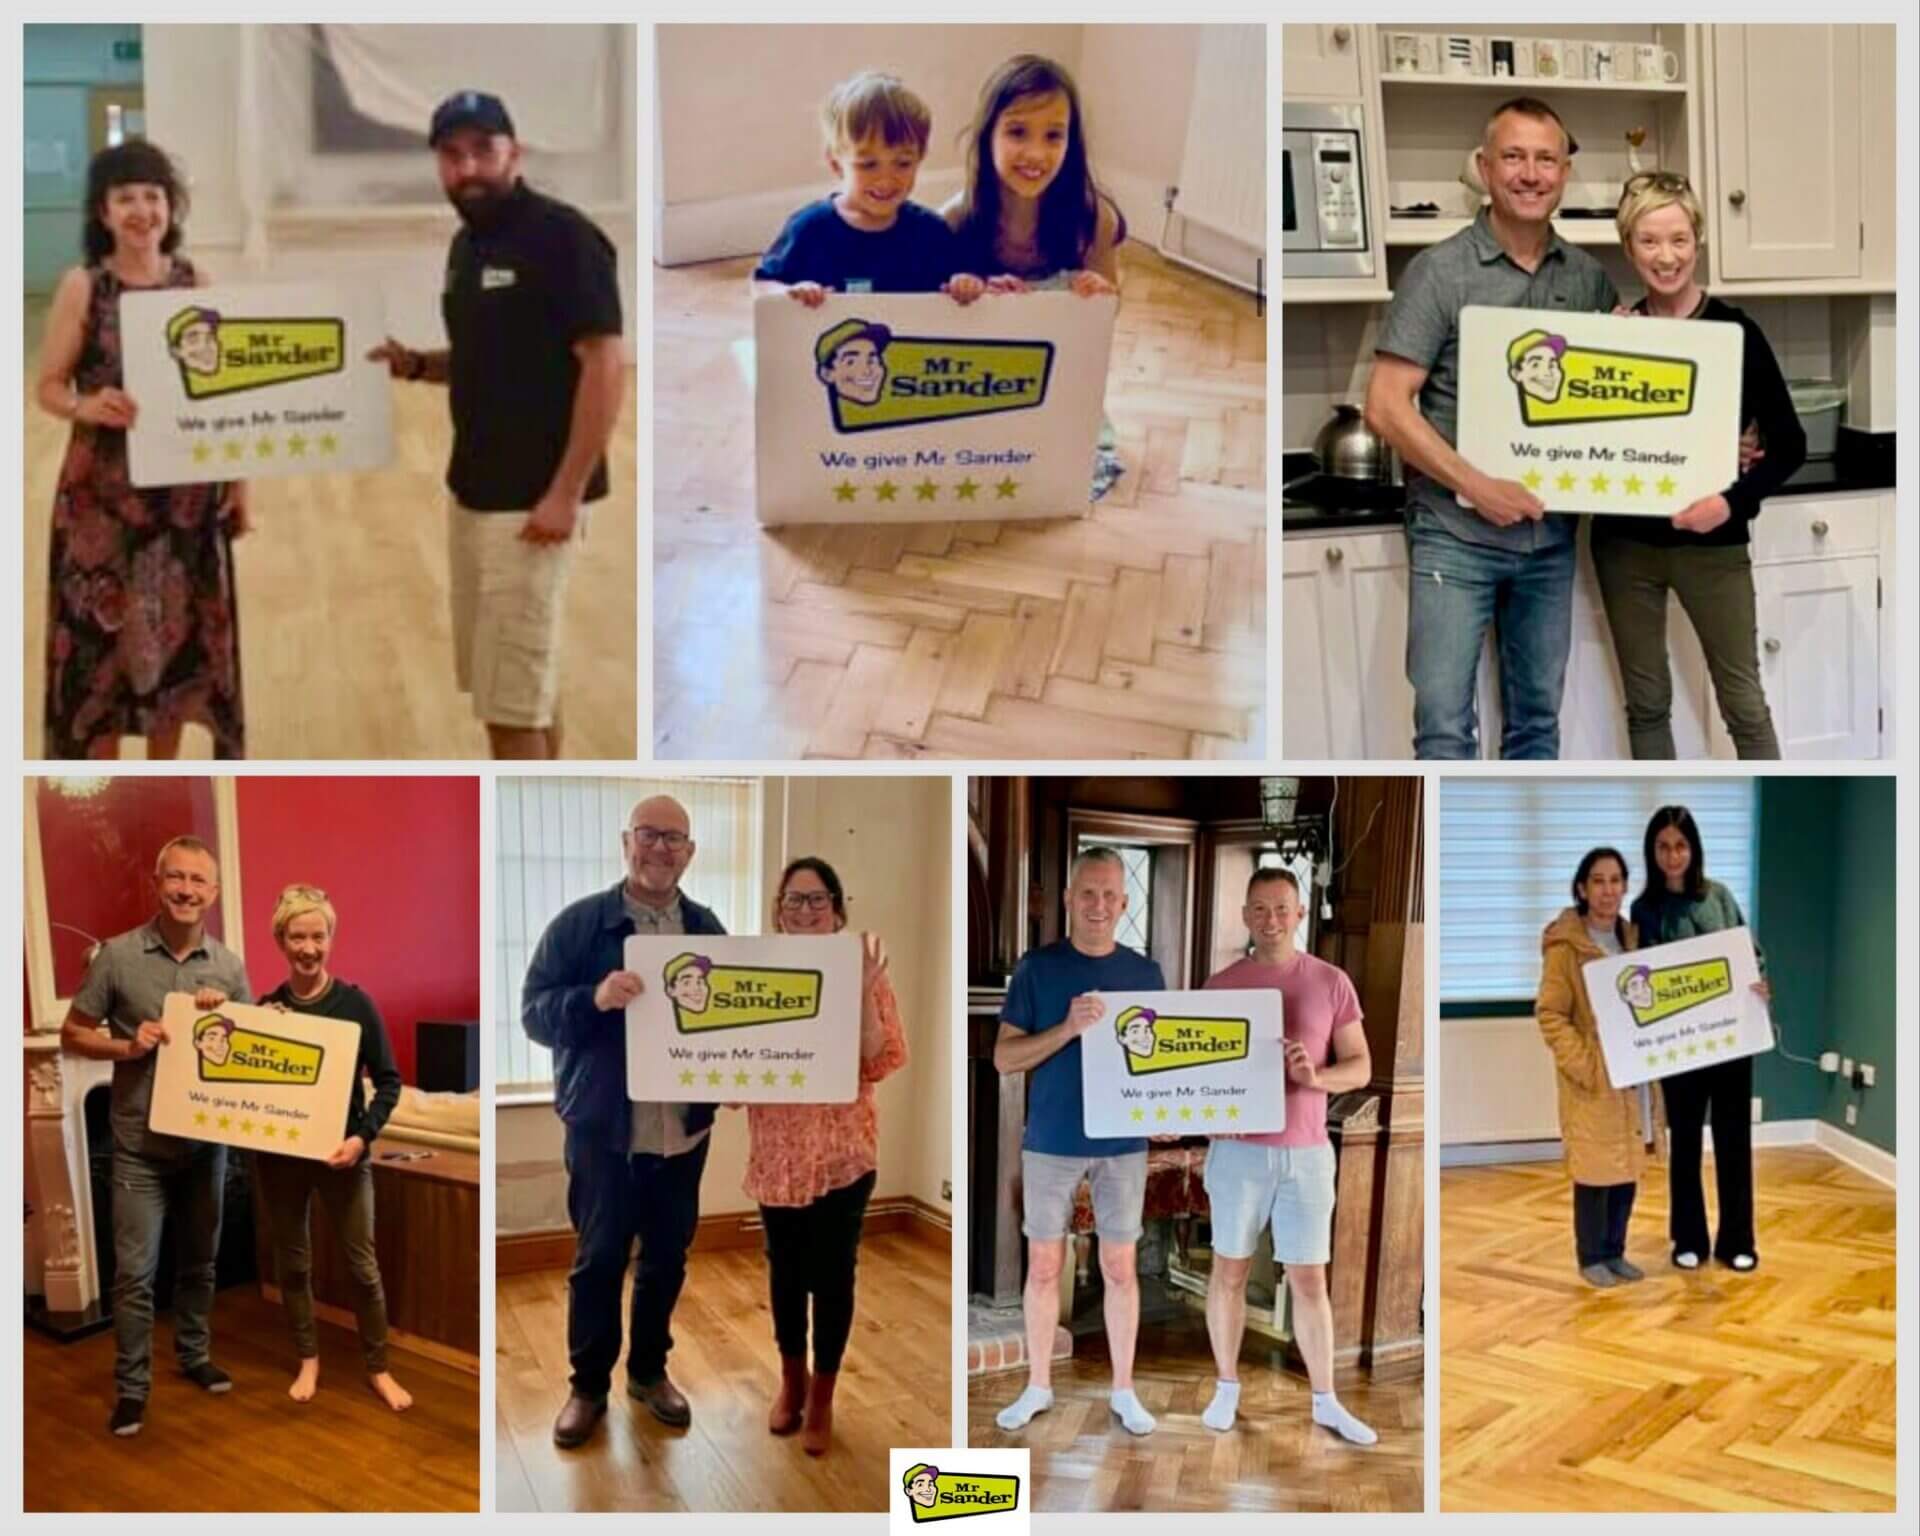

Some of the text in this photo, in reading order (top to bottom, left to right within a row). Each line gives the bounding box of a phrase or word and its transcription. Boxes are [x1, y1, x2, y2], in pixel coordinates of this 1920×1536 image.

[248, 334, 284, 347] Mr
[225, 343, 335, 367] Sander
[924, 358, 973, 374] Mr
[1592, 366, 1633, 381] Mr
[891, 373, 1036, 397] Sander
[1568, 379, 1685, 403] Sander
[820, 449, 1035, 469] We give Mr Sander
[1510, 442, 1688, 465] We give Mr Sander
[734, 980, 768, 993] Mr
[1668, 974, 1694, 986] Mr
[1656, 976, 1726, 1001] Sander
[713, 991, 812, 1009] Sander
[1176, 1028, 1206, 1039] Mr
[251, 1043, 279, 1057] Mr
[1158, 1037, 1242, 1053] Sander
[668, 1048, 816, 1061] We give Mr Sander
[231, 1051, 313, 1076] Sander
[1121, 1086, 1248, 1100] We give Mr Sander
[189, 1090, 310, 1120] We give Mr Sander
